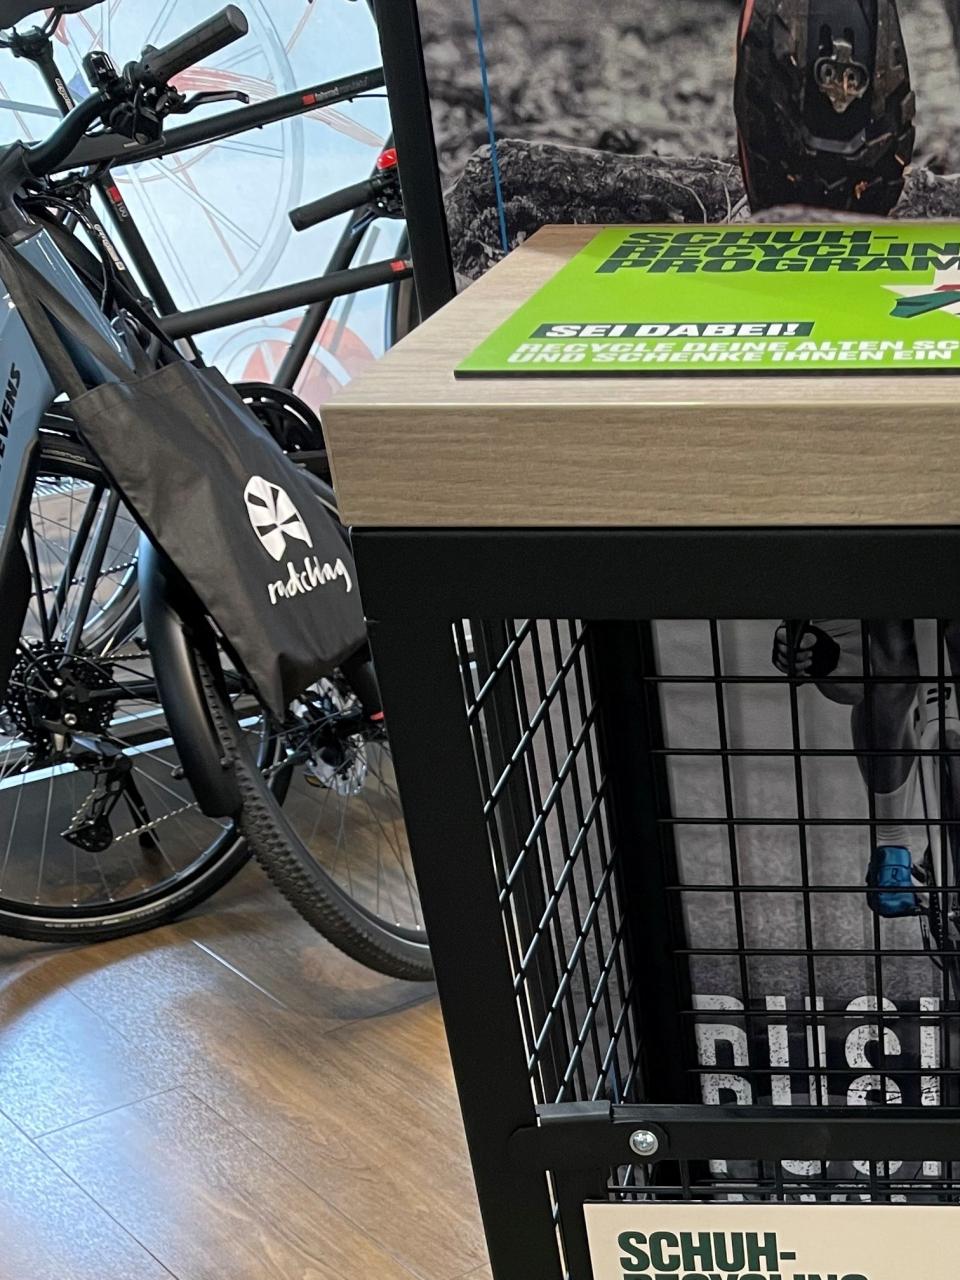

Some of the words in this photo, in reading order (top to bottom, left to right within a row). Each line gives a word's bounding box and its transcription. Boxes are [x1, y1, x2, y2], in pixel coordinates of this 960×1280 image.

[622, 231, 899, 245] SCHUH-
[545, 324, 628, 338] SEI
[634, 323, 799, 337] DABEI!
[515, 342, 679, 353] RECYCLE
[682, 341, 789, 352] DEINE
[797, 340, 904, 351] ALTEN
[507, 352, 586, 363] UND
[592, 351, 764, 362] SCHENKE
[771, 350, 884, 361] IHNEN
[893, 349, 954, 361] EIN
[0, 362, 21, 473] EVENS
[617, 1231, 796, 1272] SCHUH-
